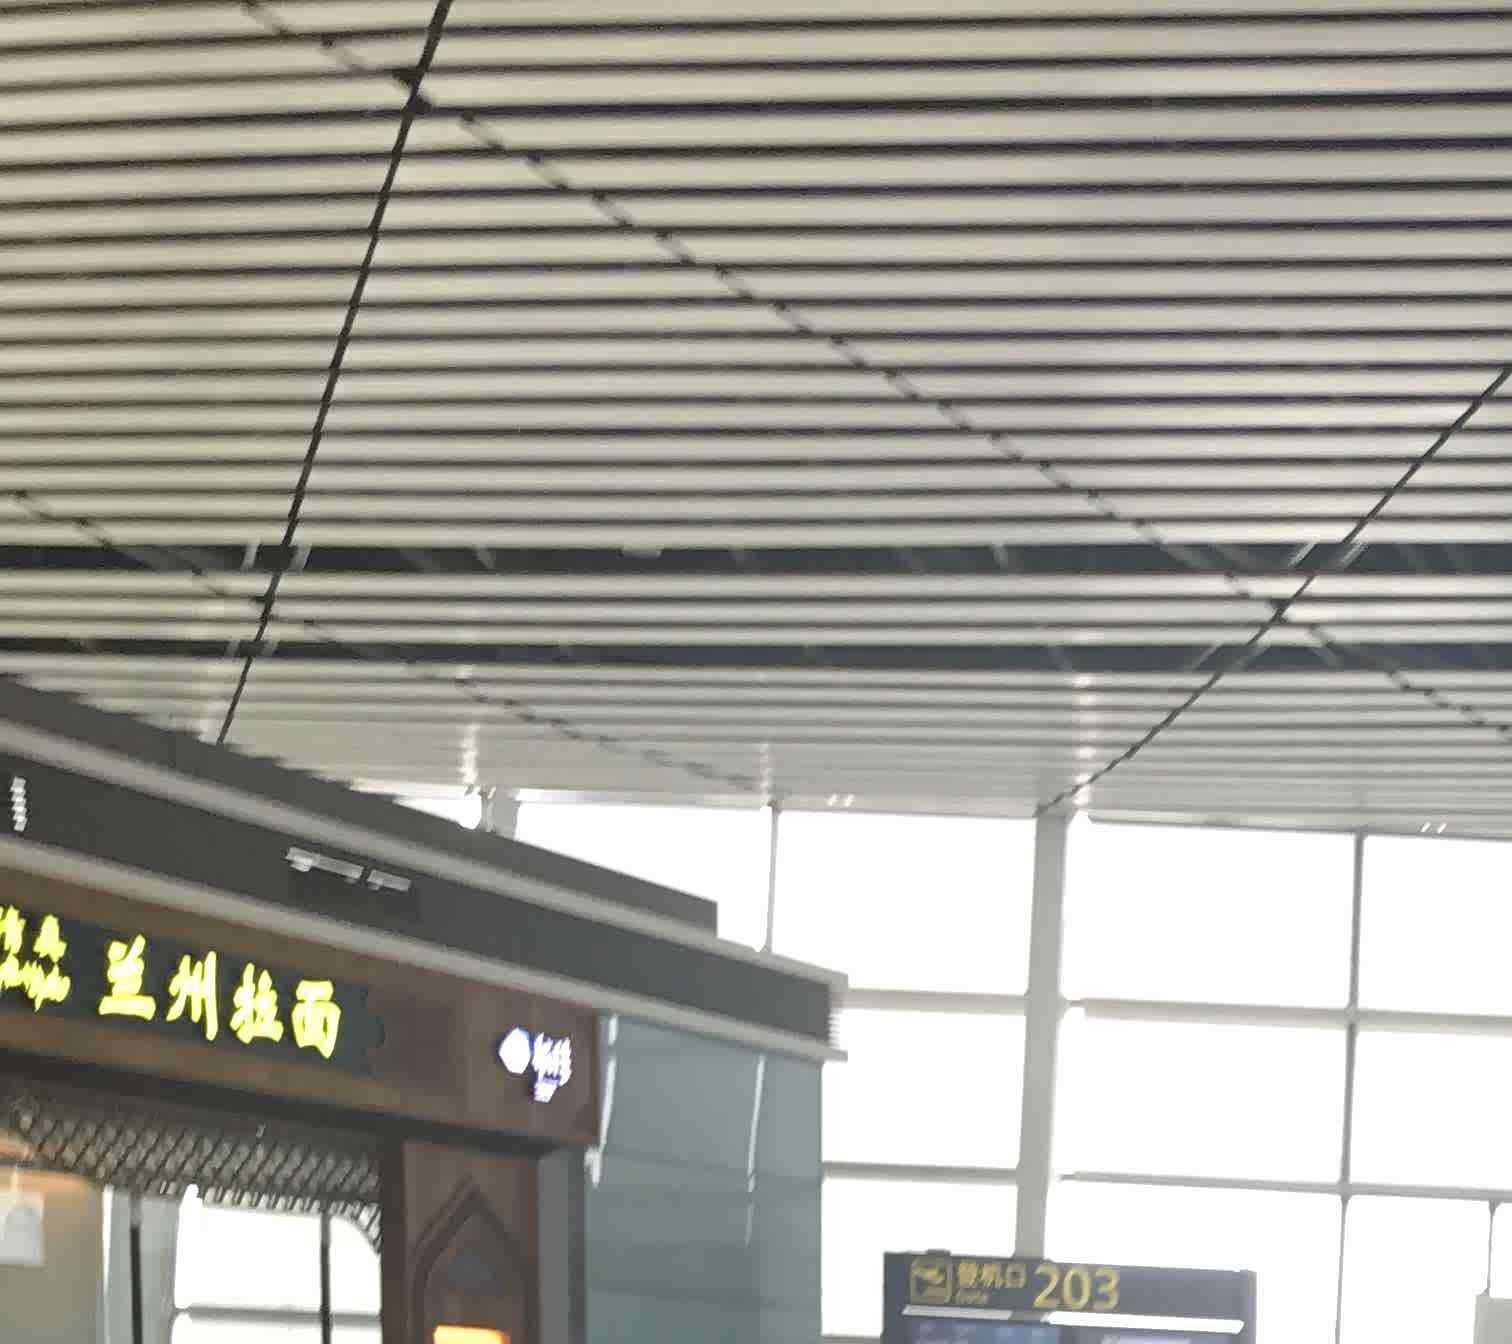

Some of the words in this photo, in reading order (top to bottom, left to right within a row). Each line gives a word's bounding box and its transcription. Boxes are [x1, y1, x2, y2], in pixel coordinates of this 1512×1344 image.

[98, 934, 341, 1057] 兰州拉面
[1033, 1264, 1120, 1310] 203
